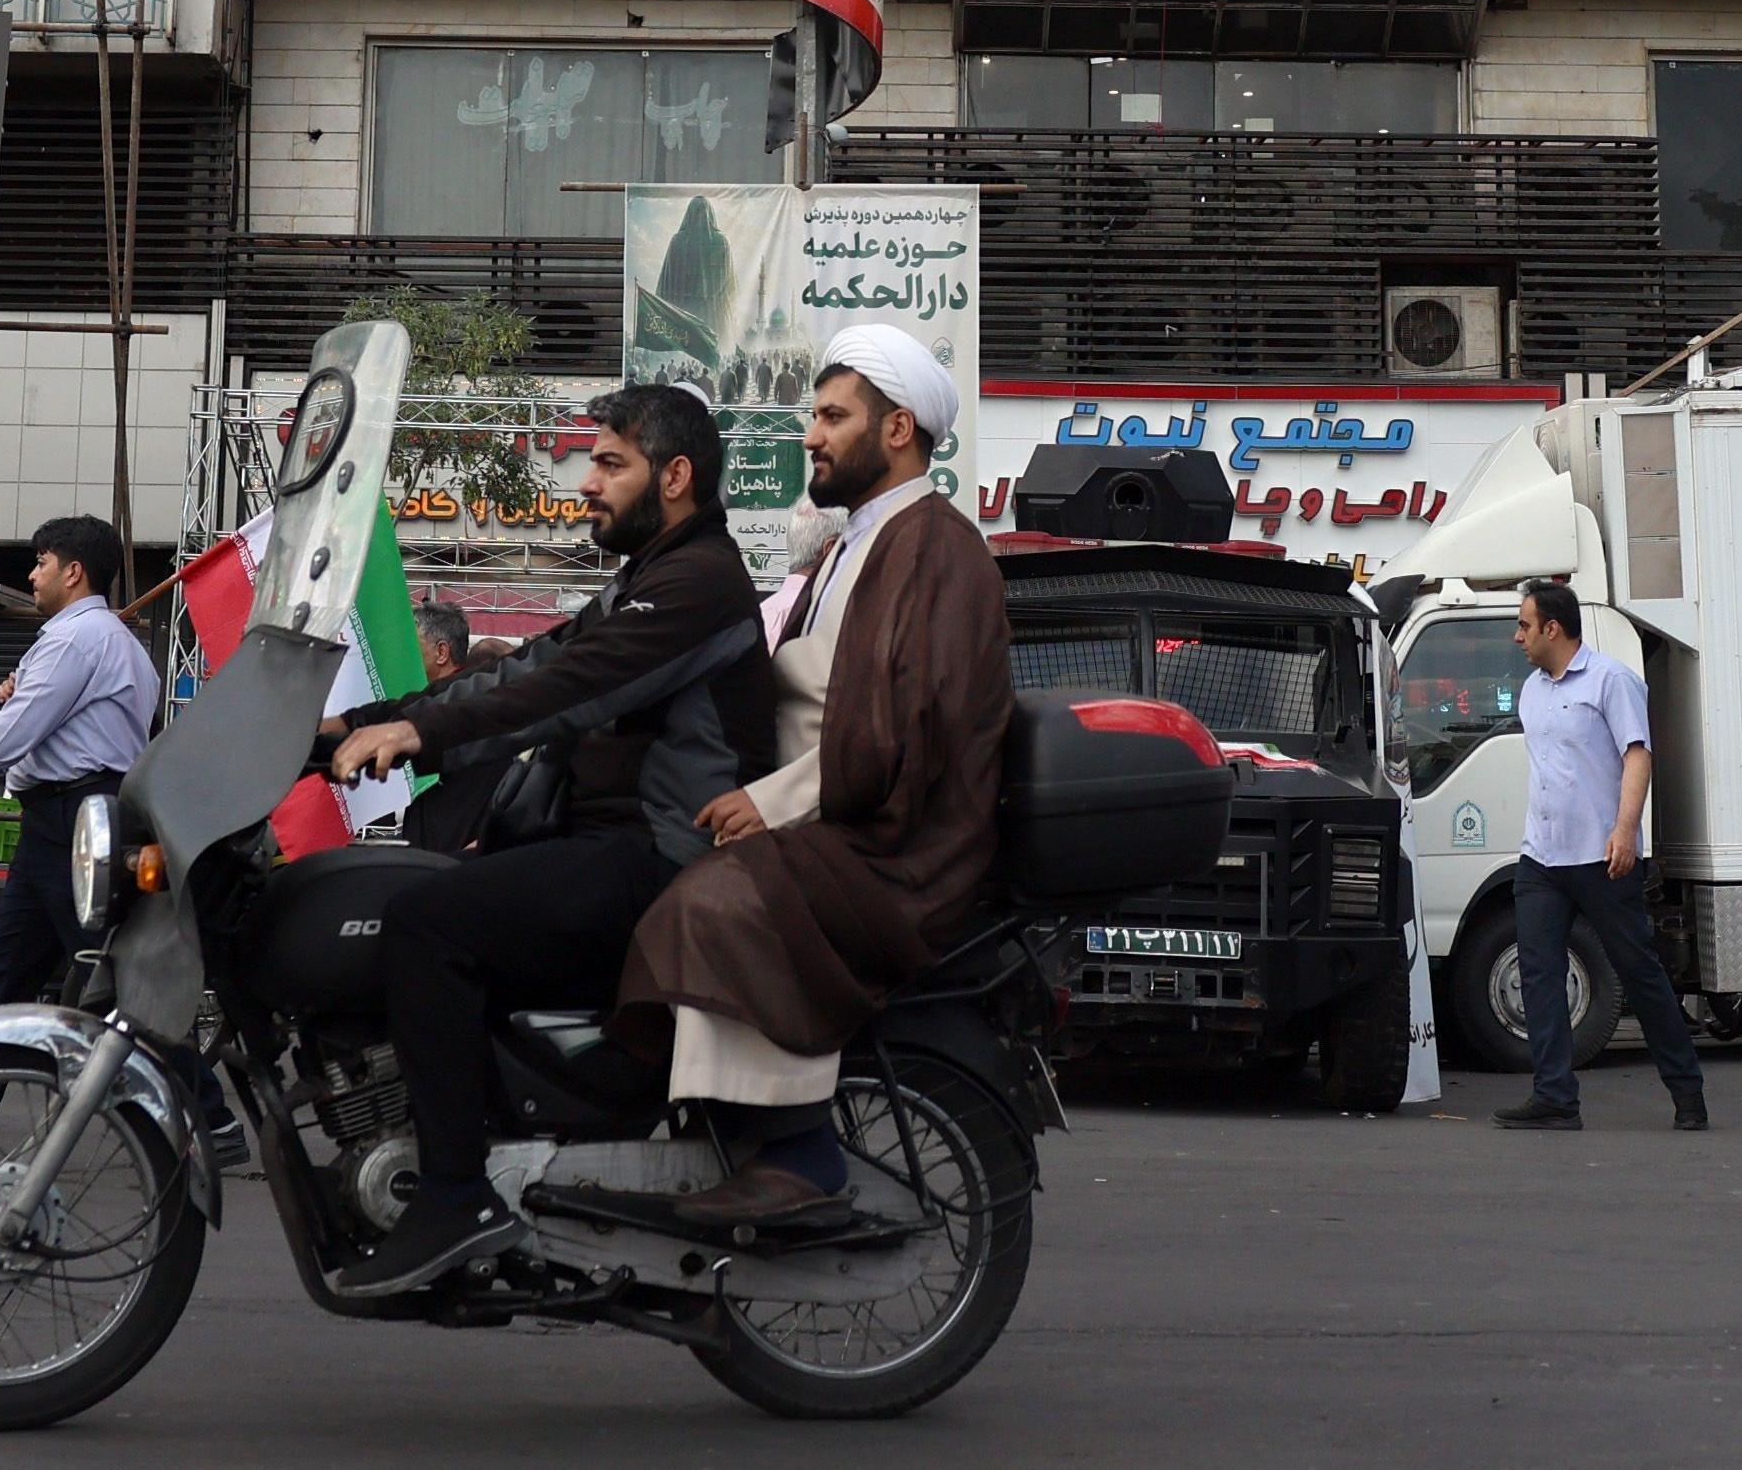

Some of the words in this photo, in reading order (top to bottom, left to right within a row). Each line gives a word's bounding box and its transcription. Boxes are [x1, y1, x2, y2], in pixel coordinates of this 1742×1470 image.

[803, 206, 849, 228] پذیرش
[850, 210, 880, 226] دوره
[882, 206, 968, 228] چهاردهمین
[802, 230, 881, 267] علمیه
[883, 236, 968, 269] حوزه
[801, 272, 969, 322] دارالحکمه
[1055, 400, 1209, 448] نبوت
[1230, 400, 1415, 472] مجتمع
[727, 454, 777, 470] استاد
[727, 474, 783, 498] پناهیان
